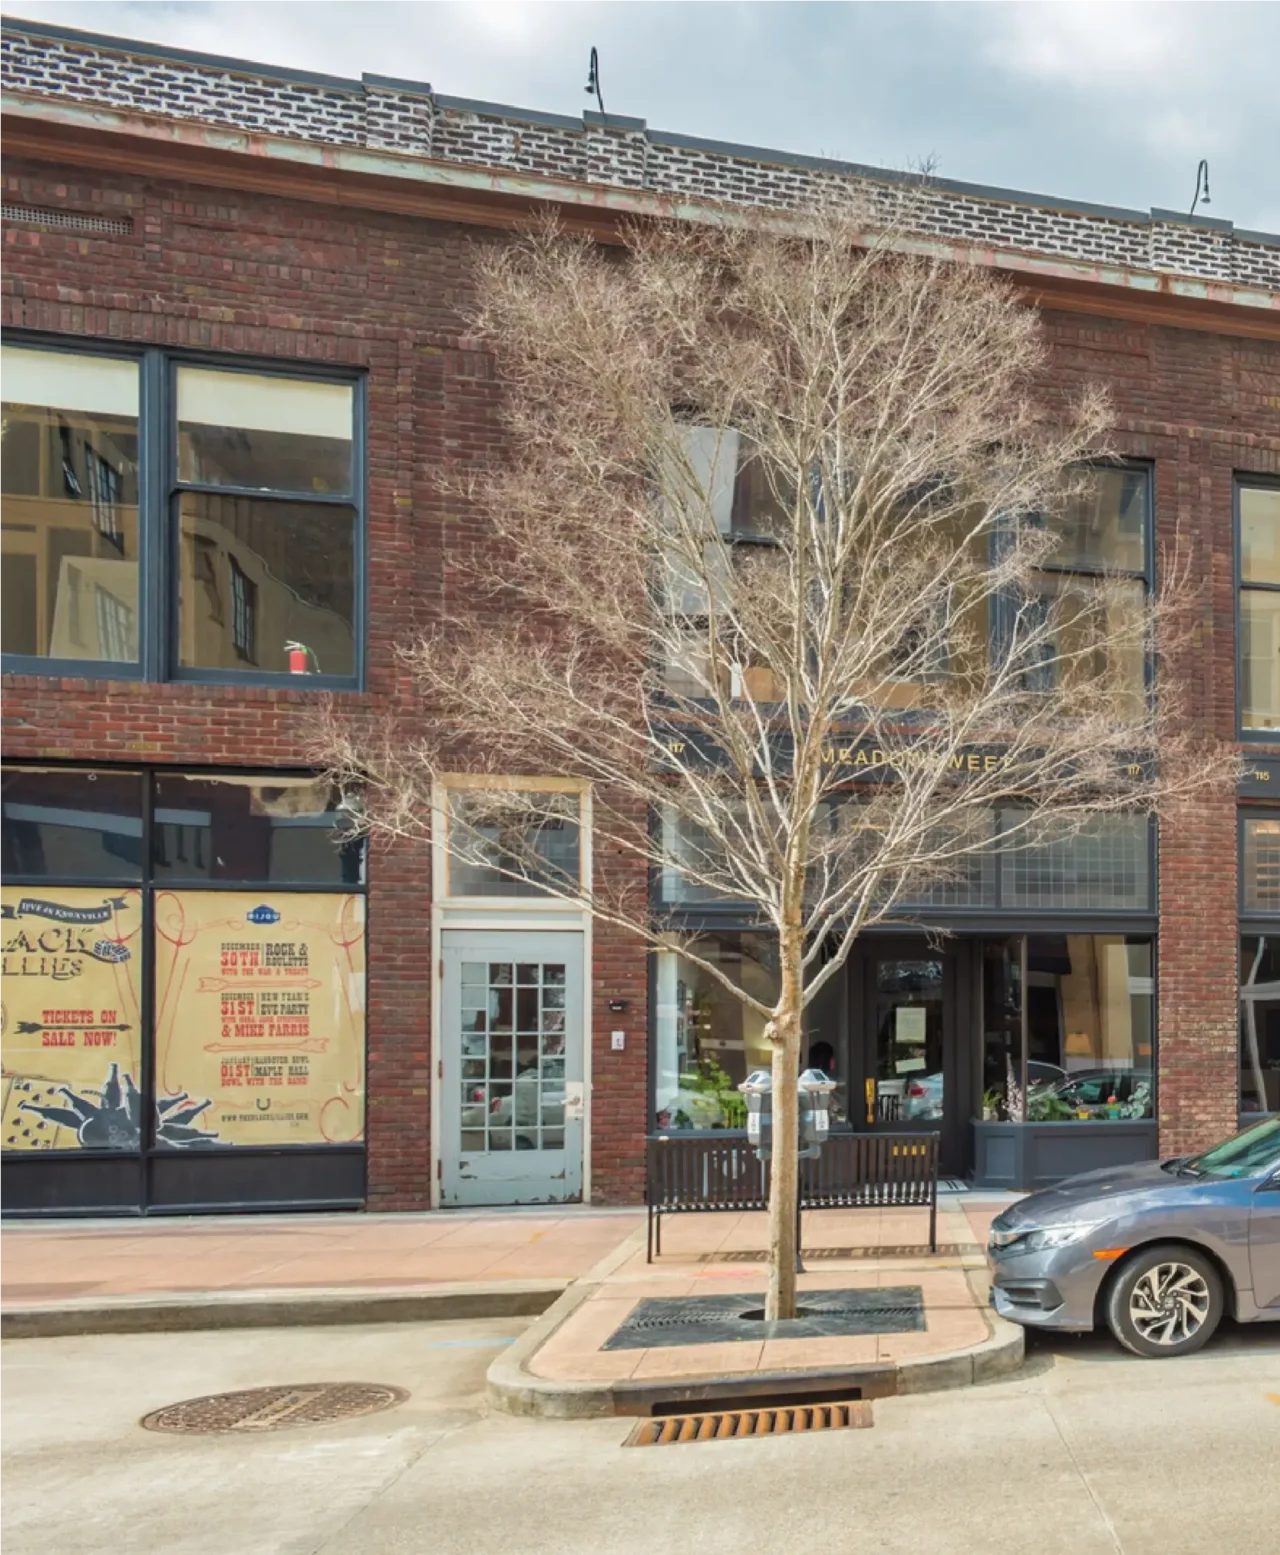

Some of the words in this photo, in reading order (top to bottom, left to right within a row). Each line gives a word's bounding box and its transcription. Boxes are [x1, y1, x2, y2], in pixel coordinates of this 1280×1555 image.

[820, 748, 1015, 773] MEADOWEET
[1254, 771, 1270, 781] 115
[265, 943, 295, 956] ROCK
[298, 943, 308, 956] &
[221, 951, 259, 967] 30TH
[265, 957, 309, 967] ROULETTE
[242, 968, 254, 976] THE
[260, 992, 279, 1001] NEW
[221, 1001, 254, 1016] 31ST
[260, 1003, 278, 1016] EVE
[280, 1003, 309, 1016] PARTY
[41, 1010, 94, 1024] TICKETS
[100, 1010, 118, 1024] ON
[222, 1024, 231, 1037] &
[234, 1023, 264, 1037] MIKE
[268, 1023, 309, 1037] FARRIS
[41, 1032, 75, 1047] SALE
[84, 1032, 117, 1047] NOW!
[221, 1065, 250, 1077] 01ST
[255, 1065, 283, 1077] MAPLE
[288, 1065, 309, 1076] HALL
[269, 1077, 282, 1086] THE
